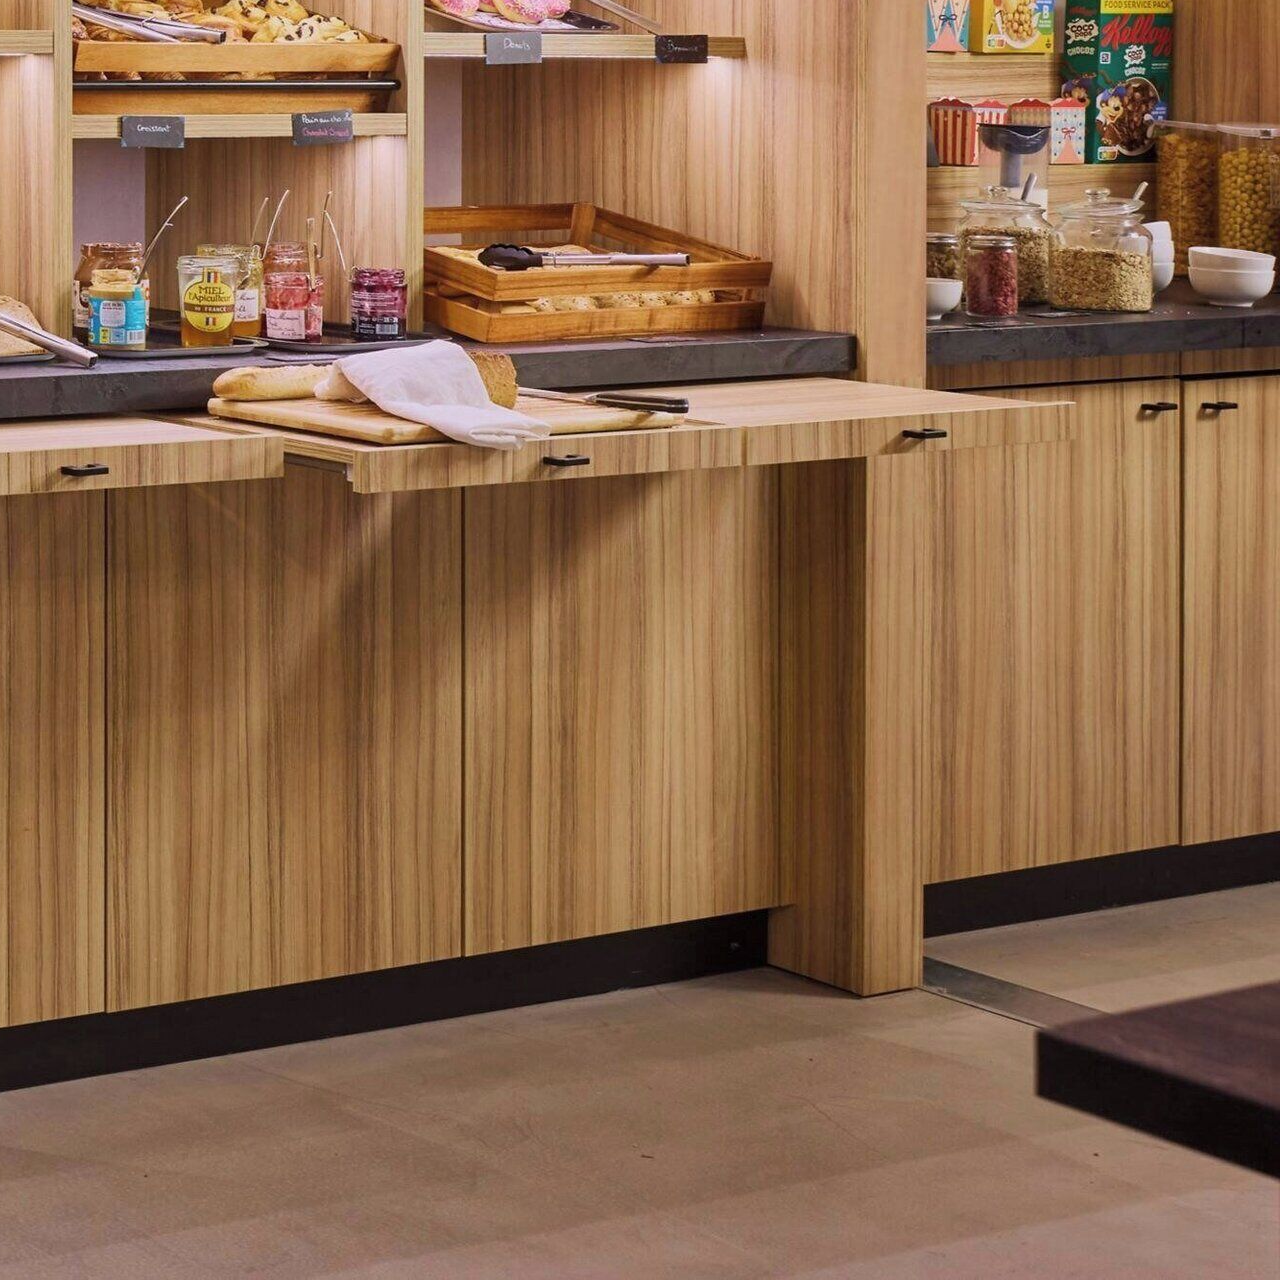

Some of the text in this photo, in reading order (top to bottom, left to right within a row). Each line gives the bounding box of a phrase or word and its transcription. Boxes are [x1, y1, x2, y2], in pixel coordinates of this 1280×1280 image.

[1104, 0, 1170, 9] FOOD SERVICE PACK
[1070, 24, 1095, 33] COCO
[1074, 30, 1093, 39] pops
[198, 286, 224, 295] MIEL
